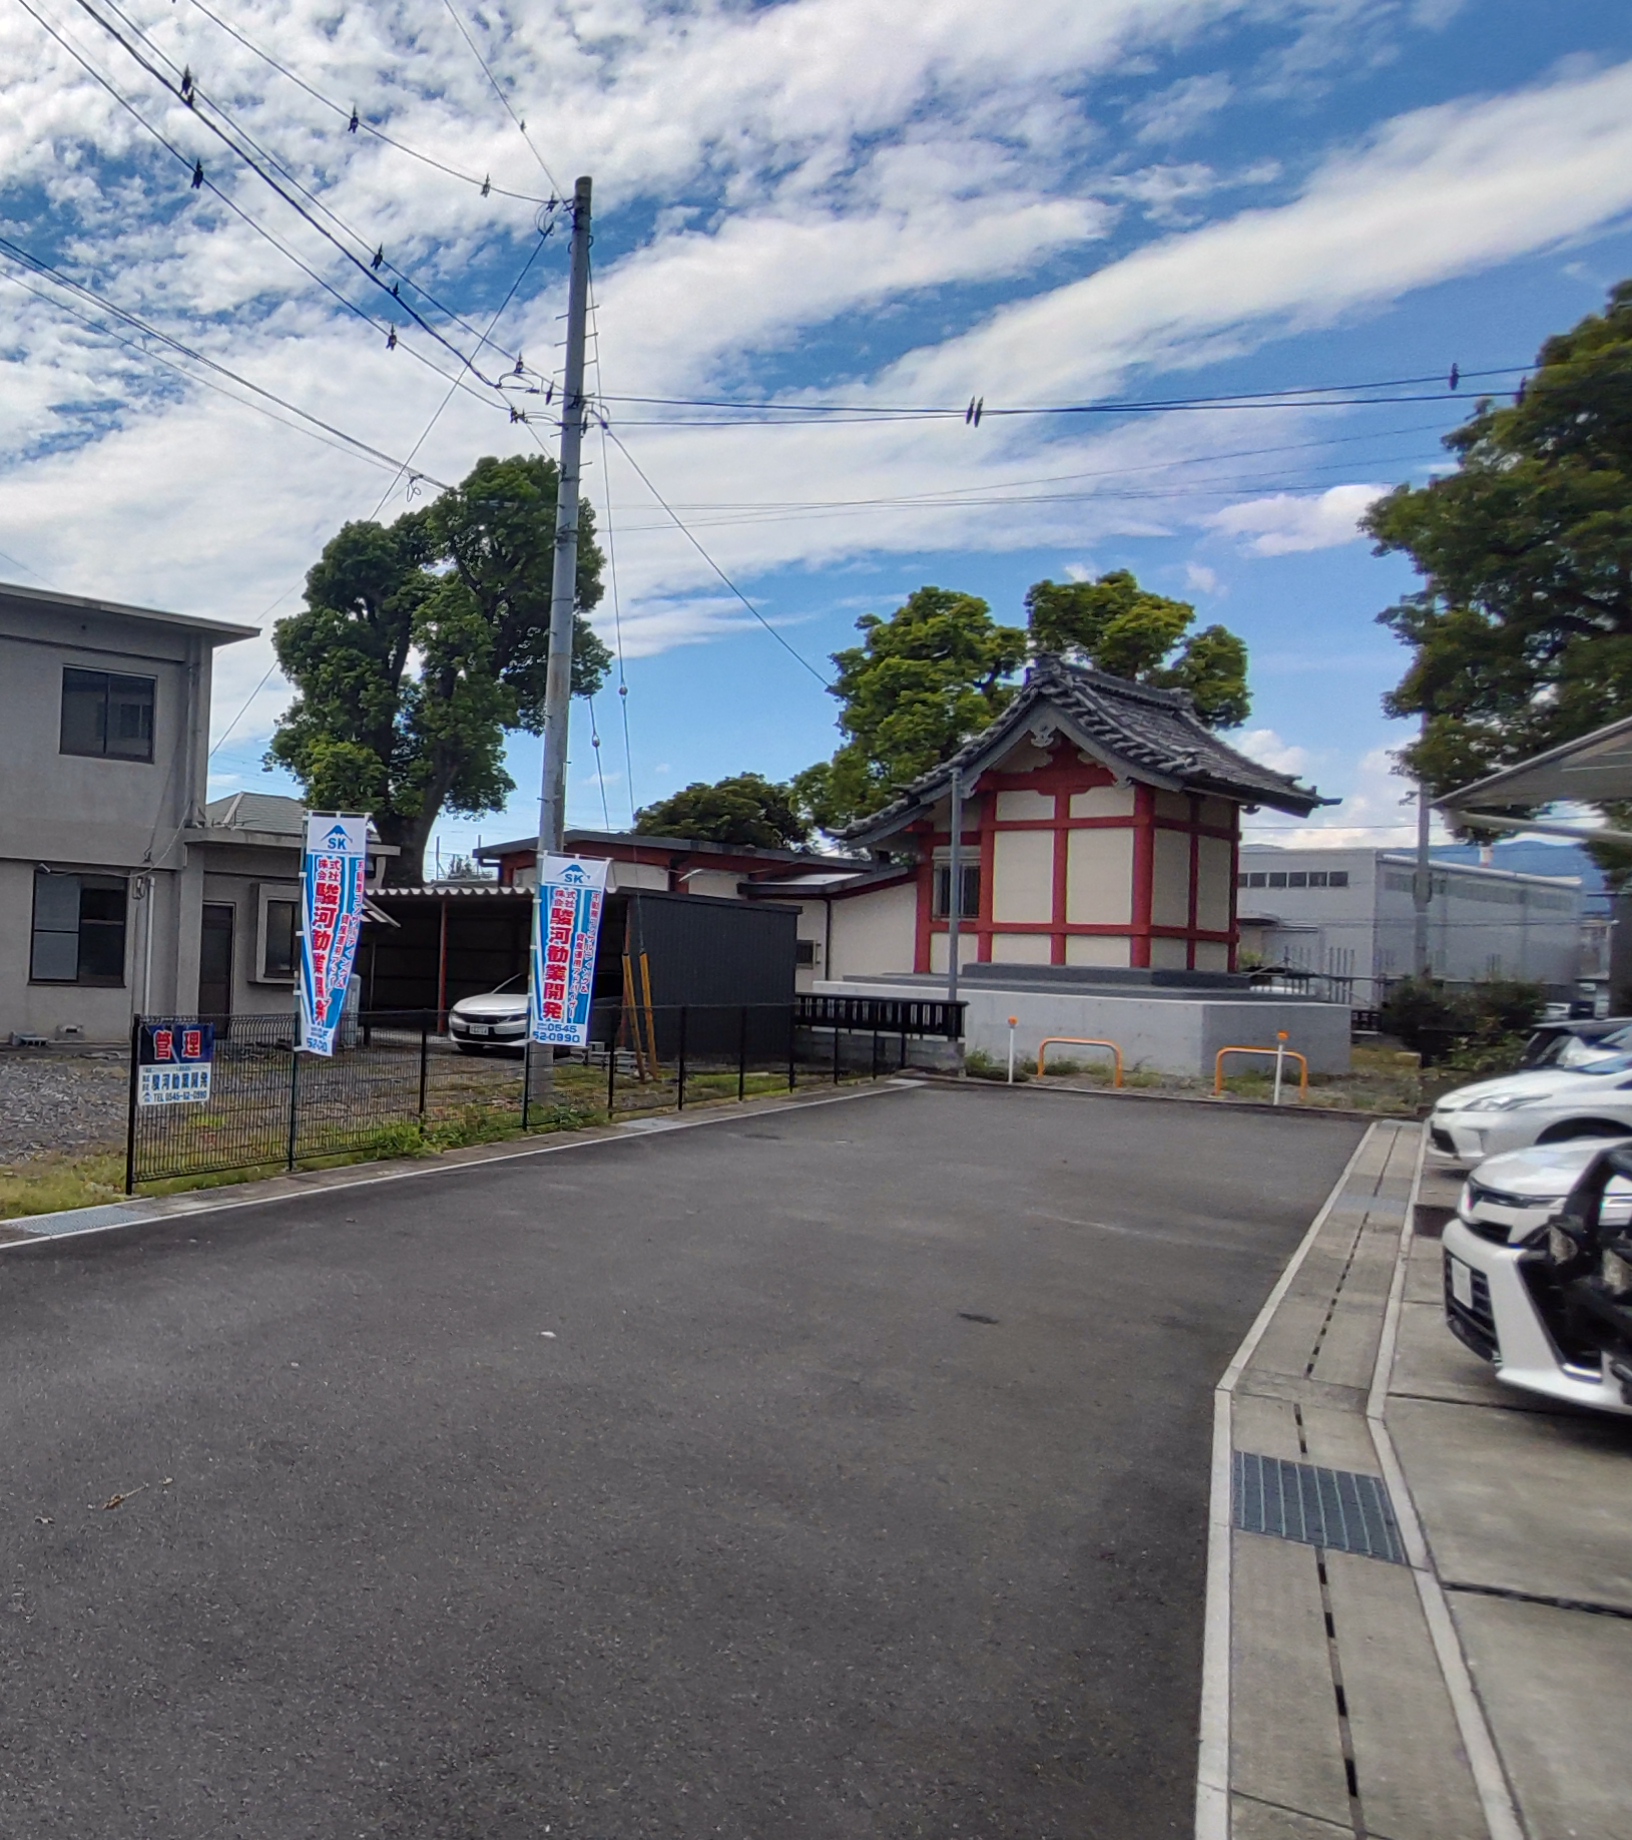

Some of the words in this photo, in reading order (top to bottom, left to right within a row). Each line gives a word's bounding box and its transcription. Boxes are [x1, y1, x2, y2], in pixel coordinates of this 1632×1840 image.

[327, 837, 346, 850] SK
[318, 859, 341, 871] 株式
[317, 871, 340, 882] 会社
[564, 873, 584, 884] SK
[553, 889, 576, 900] 株式
[552, 899, 575, 909] 会社
[542, 907, 575, 1020] 駿河勧業開発
[533, 1031, 580, 1043] 52-0990
[153, 1030, 202, 1060] 管理
[154, 1093, 164, 1102] TEL
